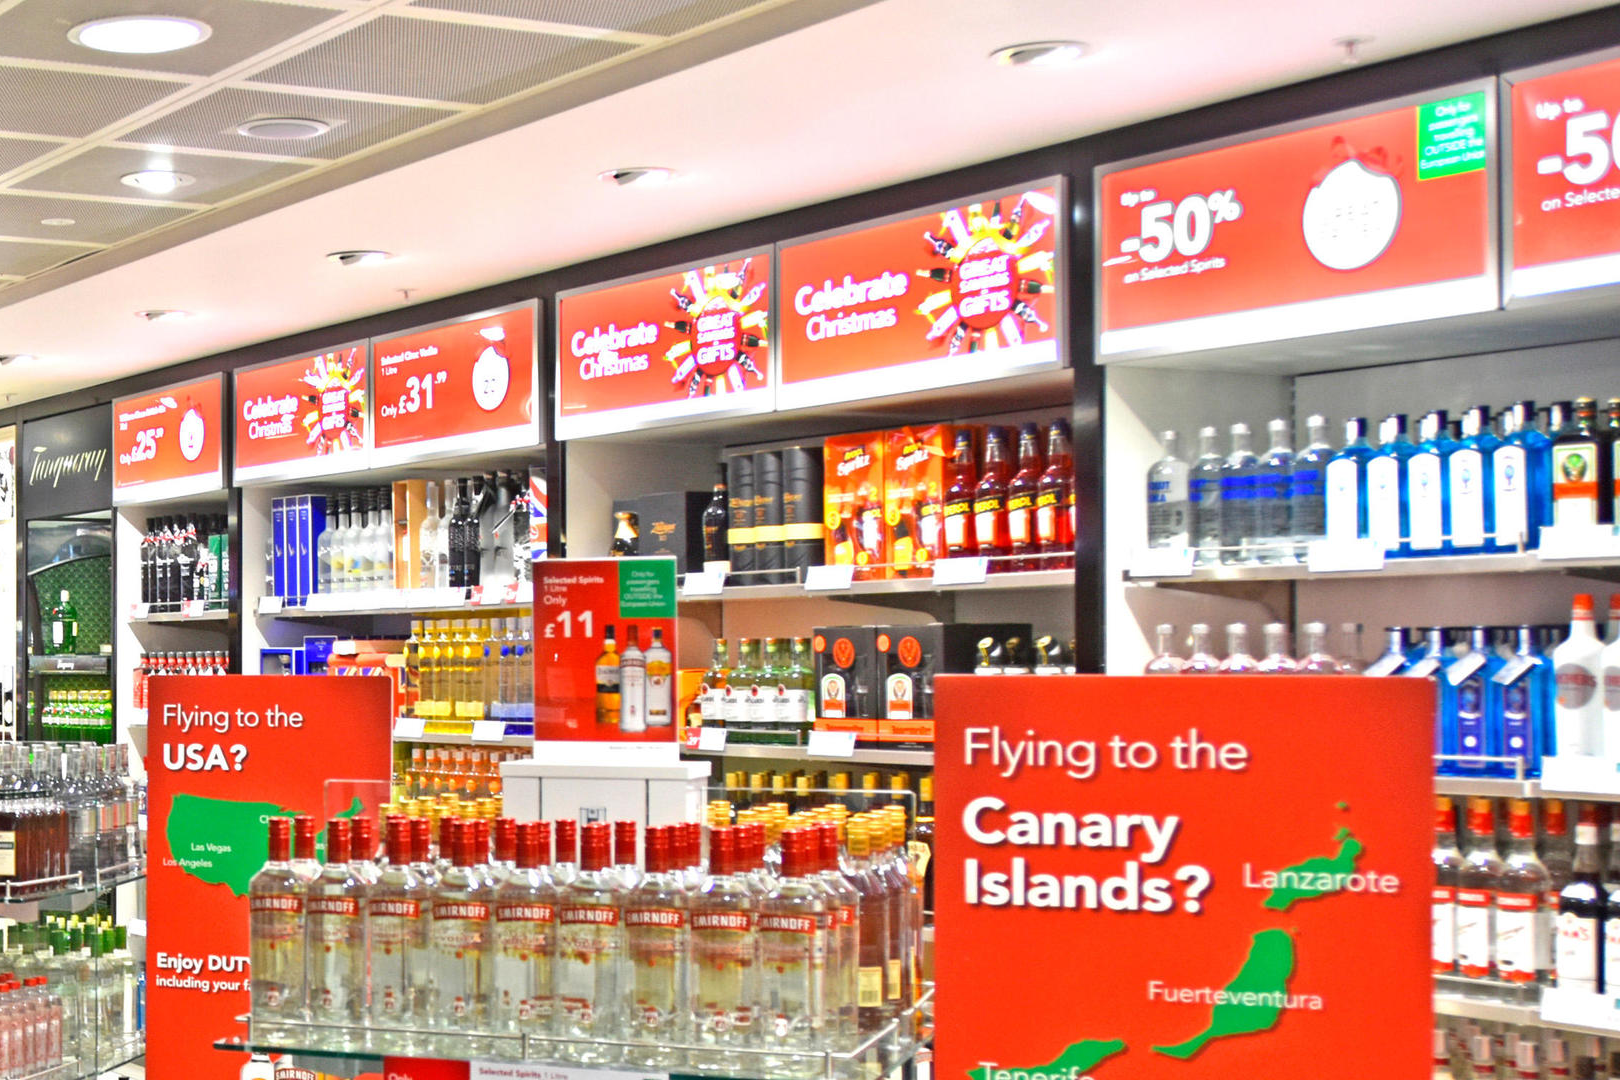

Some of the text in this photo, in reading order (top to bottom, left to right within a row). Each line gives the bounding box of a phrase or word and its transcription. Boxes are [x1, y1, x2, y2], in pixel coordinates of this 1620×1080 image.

[1535, 97, 1583, 120] Up to
[1541, 197, 1562, 212] on
[1120, 189, 1243, 263] -50%
[958, 254, 1010, 280] GREAT
[1140, 258, 1226, 281] Selected Spirits
[794, 270, 908, 316] Celebrate
[958, 289, 1011, 317] GIFTS
[805, 307, 898, 341] Christmas
[571, 322, 659, 357] Celebrate
[579, 353, 650, 380] Christmas
[696, 343, 736, 365] GIFTS
[242, 394, 299, 421] Celebrate
[381, 404, 397, 418] Only
[248, 421, 293, 439] Christmas
[29, 447, 107, 488] Tanqueray
[543, 576, 604, 586] Selected Spirits
[543, 595, 567, 606] Only
[544, 610, 593, 638] £11
[163, 703, 304, 733] Flying to the
[163, 743, 249, 772] USA?
[963, 727, 1248, 779] Flying to the
[962, 797, 1179, 863] Canary
[191, 842, 232, 854] Las Vegas
[162, 858, 213, 869] Los Angeles
[963, 857, 1211, 913] Islands?
[1243, 863, 1400, 893] Lanzarote
[692, 914, 748, 929] SMIRNOFF
[156, 952, 204, 974] Enjoy
[156, 975, 240, 993] including your
[1148, 981, 1323, 1010] Fuerteventura
[479, 1067, 541, 1080] Selected Spirits
